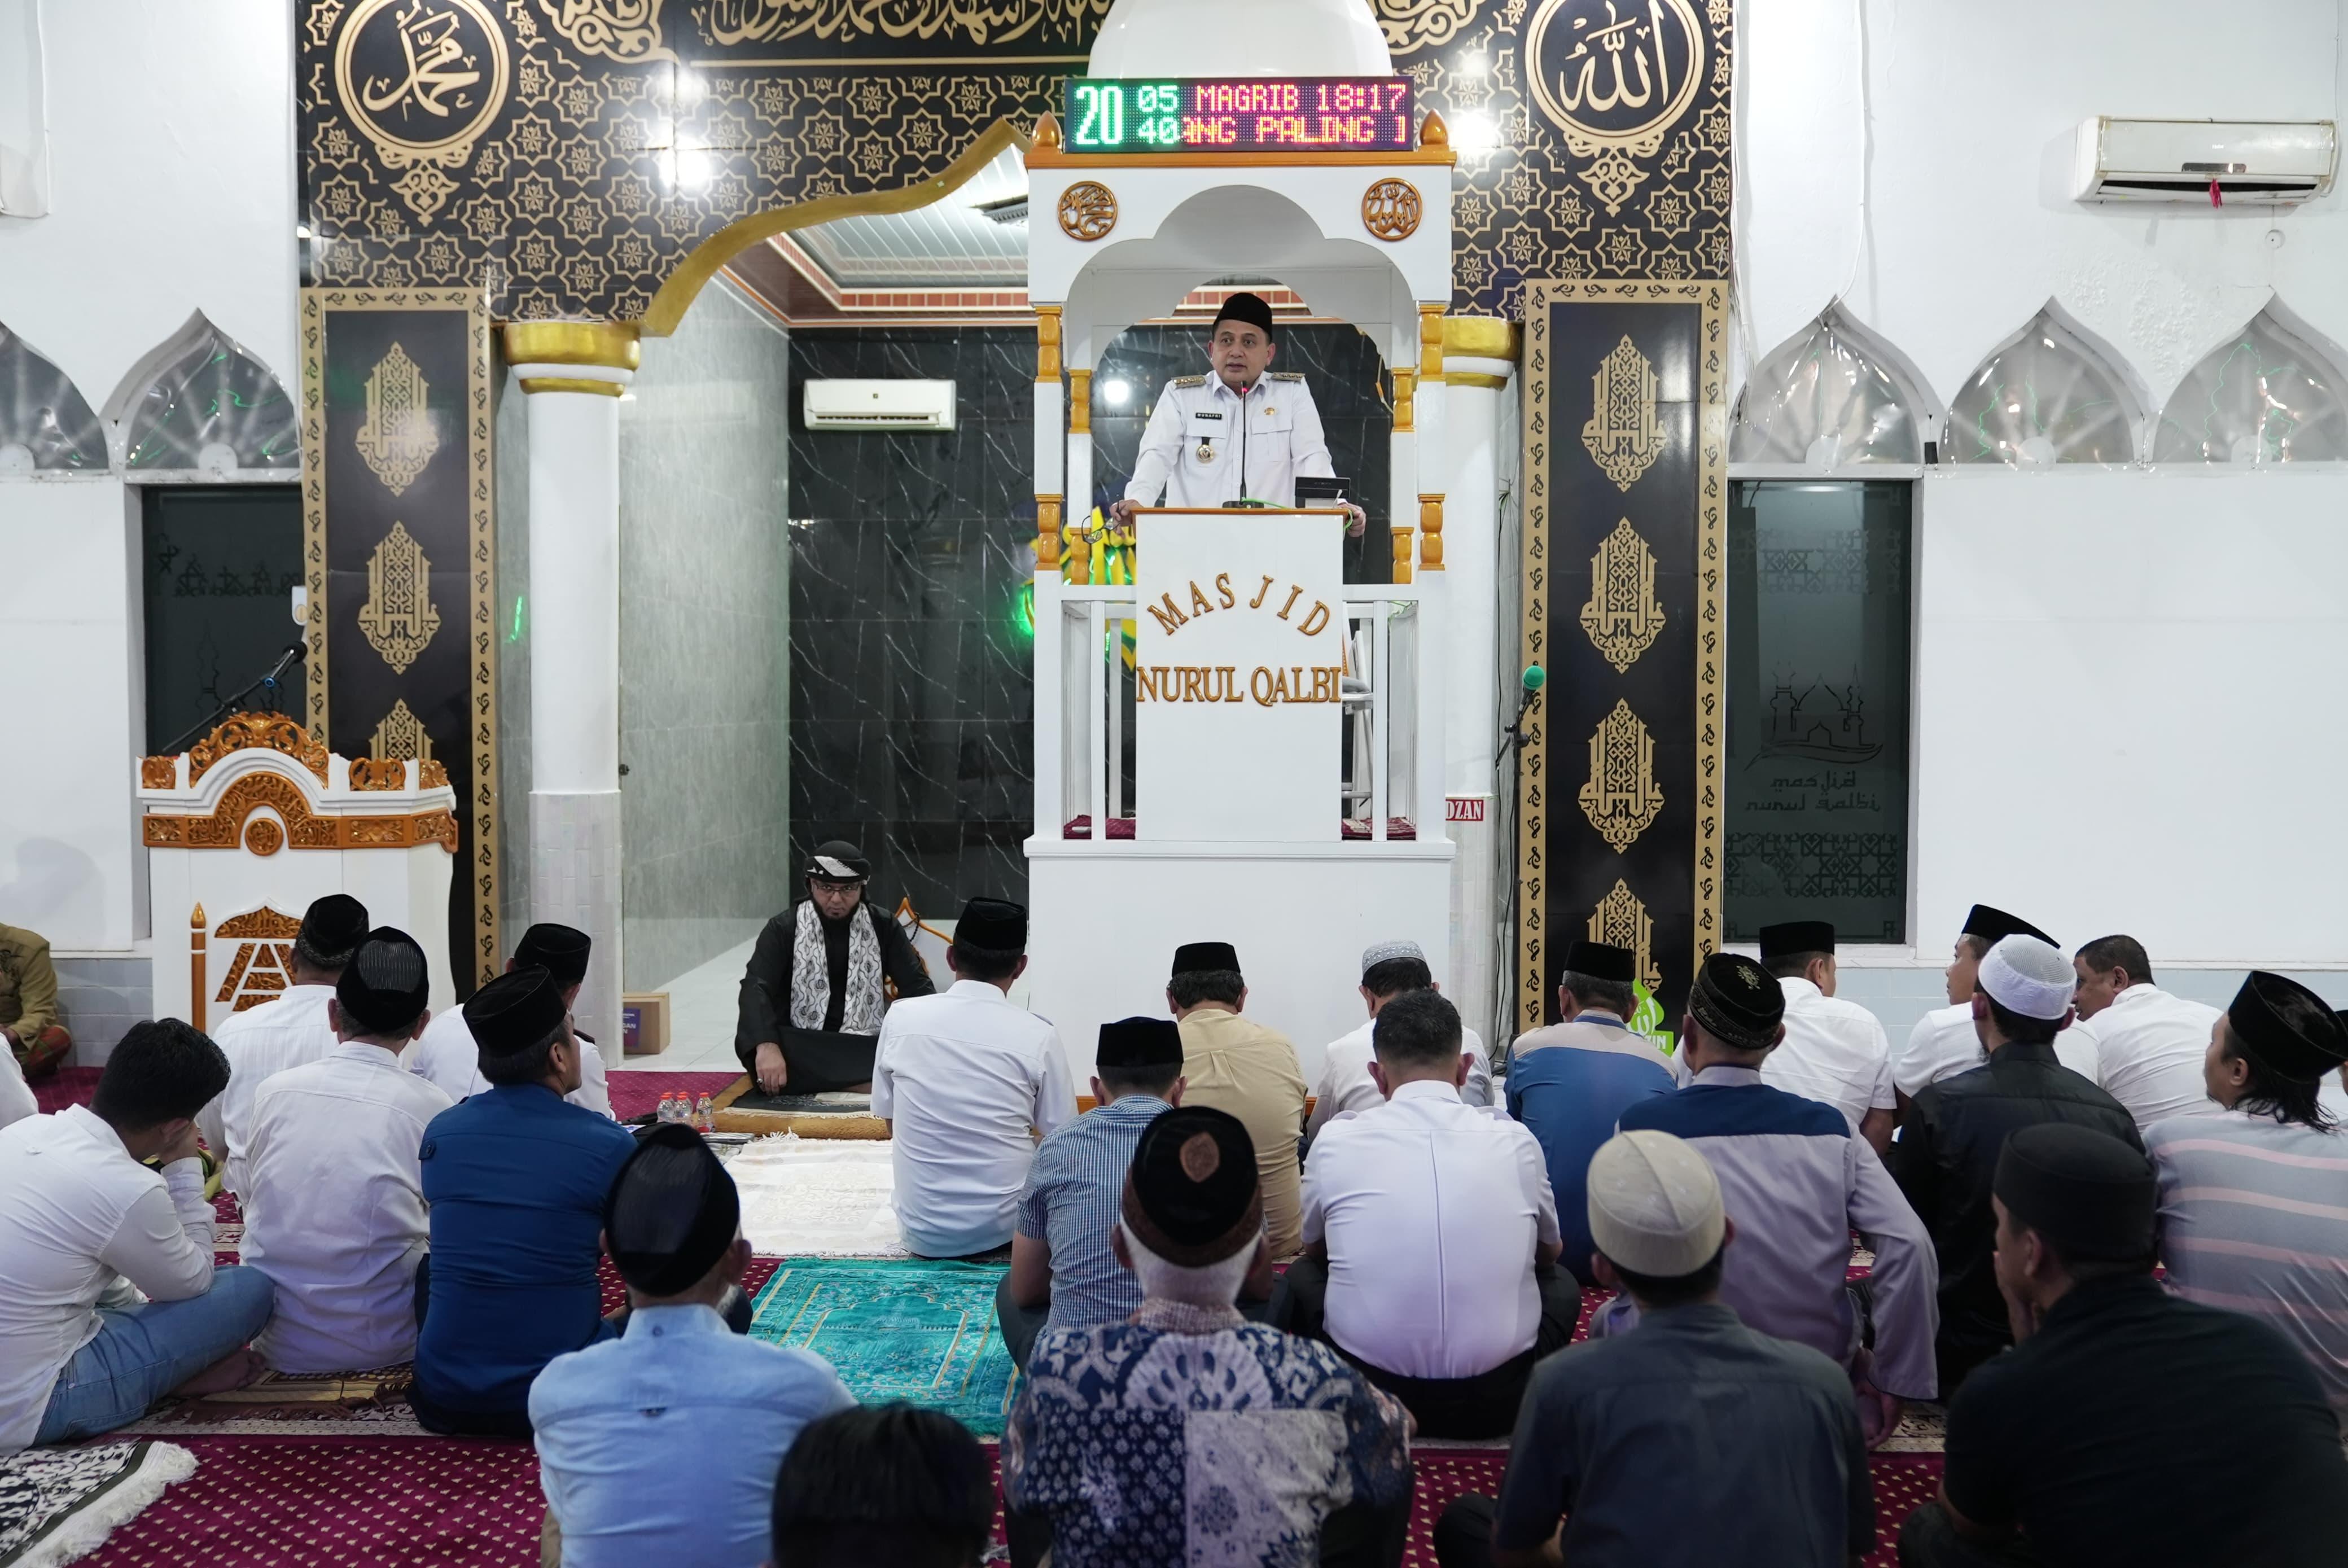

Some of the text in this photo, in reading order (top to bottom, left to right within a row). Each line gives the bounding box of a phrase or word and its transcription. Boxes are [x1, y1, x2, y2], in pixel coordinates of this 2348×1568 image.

[1138, 85, 1178, 112] 05
[1197, 85, 1406, 111] MAGRIB 18:17
[1075, 86, 1123, 144] 20
[1138, 117, 1178, 144] 40
[1255, 116, 1374, 143] PALING
[1146, 572, 1330, 636] MASJID
[1136, 666, 1342, 707] NURUL QALBI
[1446, 800, 1482, 820] DZAN
